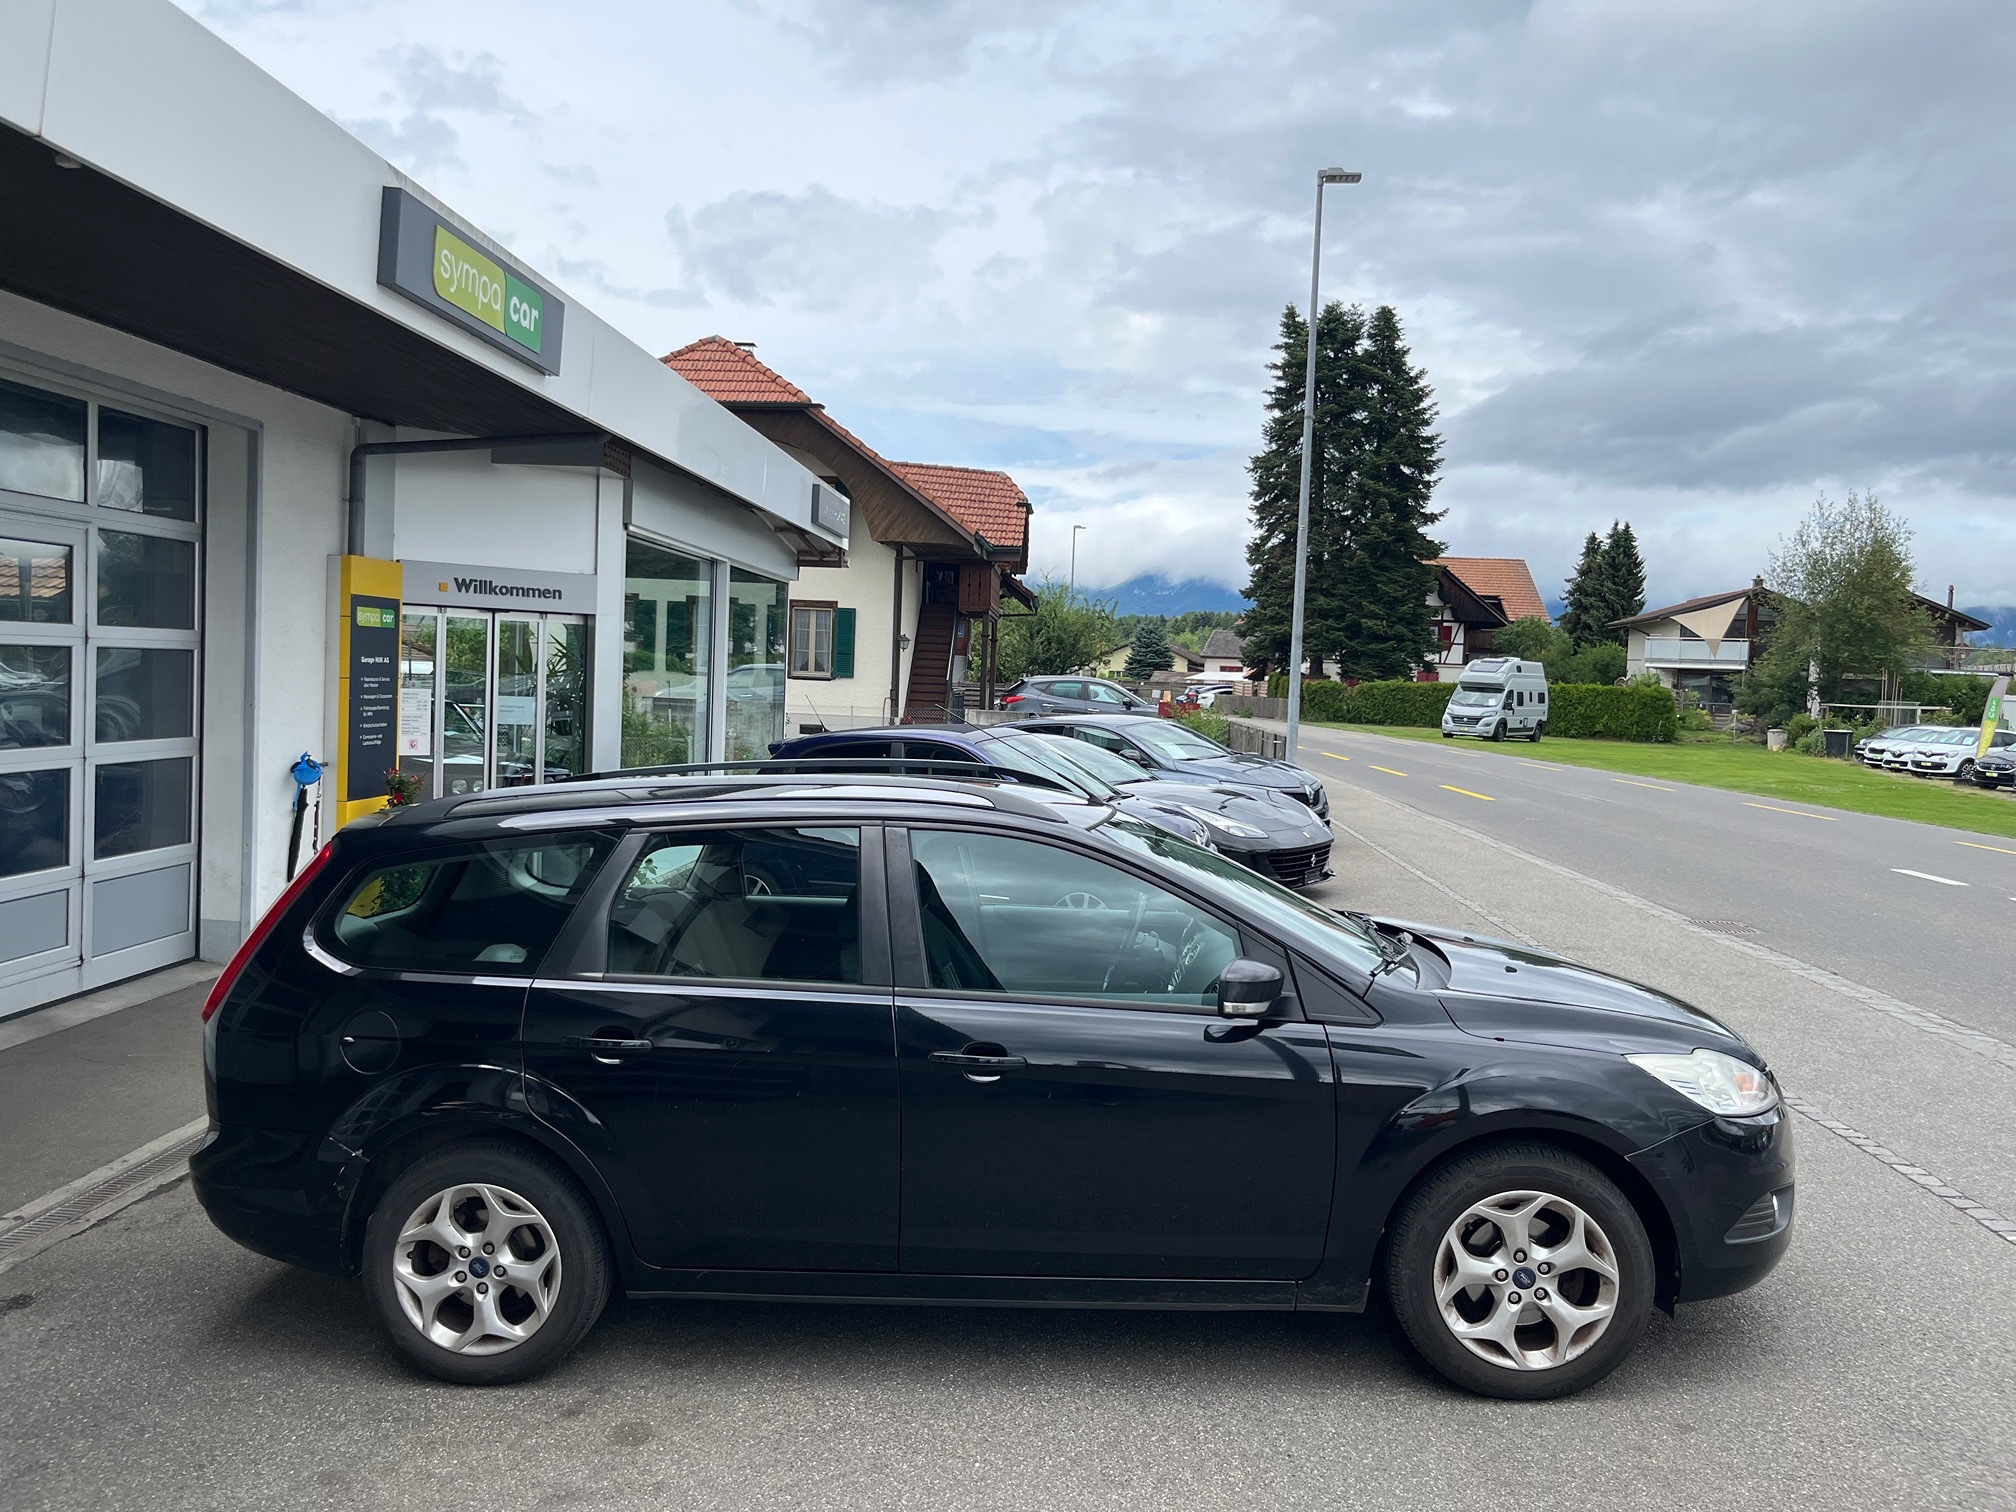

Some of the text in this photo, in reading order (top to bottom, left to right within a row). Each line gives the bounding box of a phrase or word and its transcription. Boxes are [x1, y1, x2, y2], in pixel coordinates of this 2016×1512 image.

[440, 249, 539, 332] sympa car
[453, 577, 562, 600] Willkommen
[359, 611, 394, 625] sympa car
